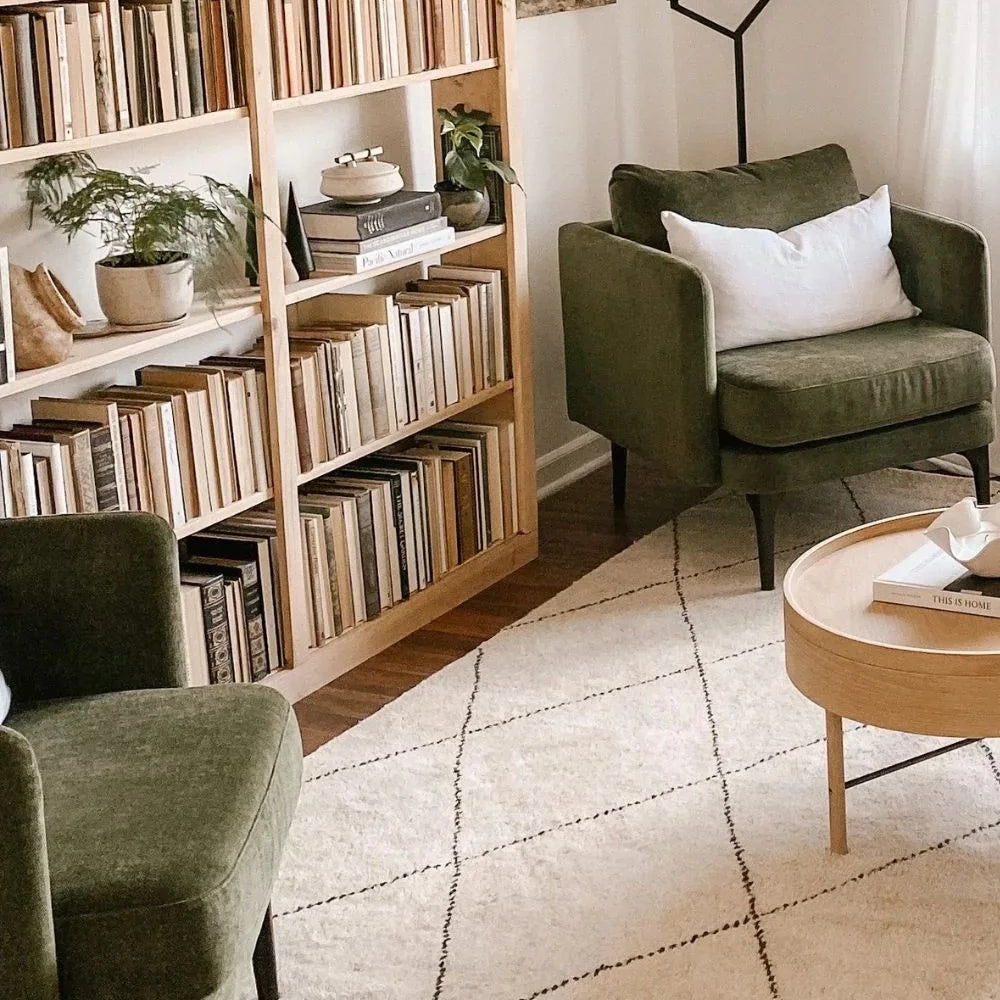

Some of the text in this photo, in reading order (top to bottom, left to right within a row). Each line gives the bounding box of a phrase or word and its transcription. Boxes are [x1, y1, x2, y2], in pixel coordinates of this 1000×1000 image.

[932, 595, 953, 606] THIS
[955, 597, 963, 606] IS
[965, 599, 992, 611] HOME
